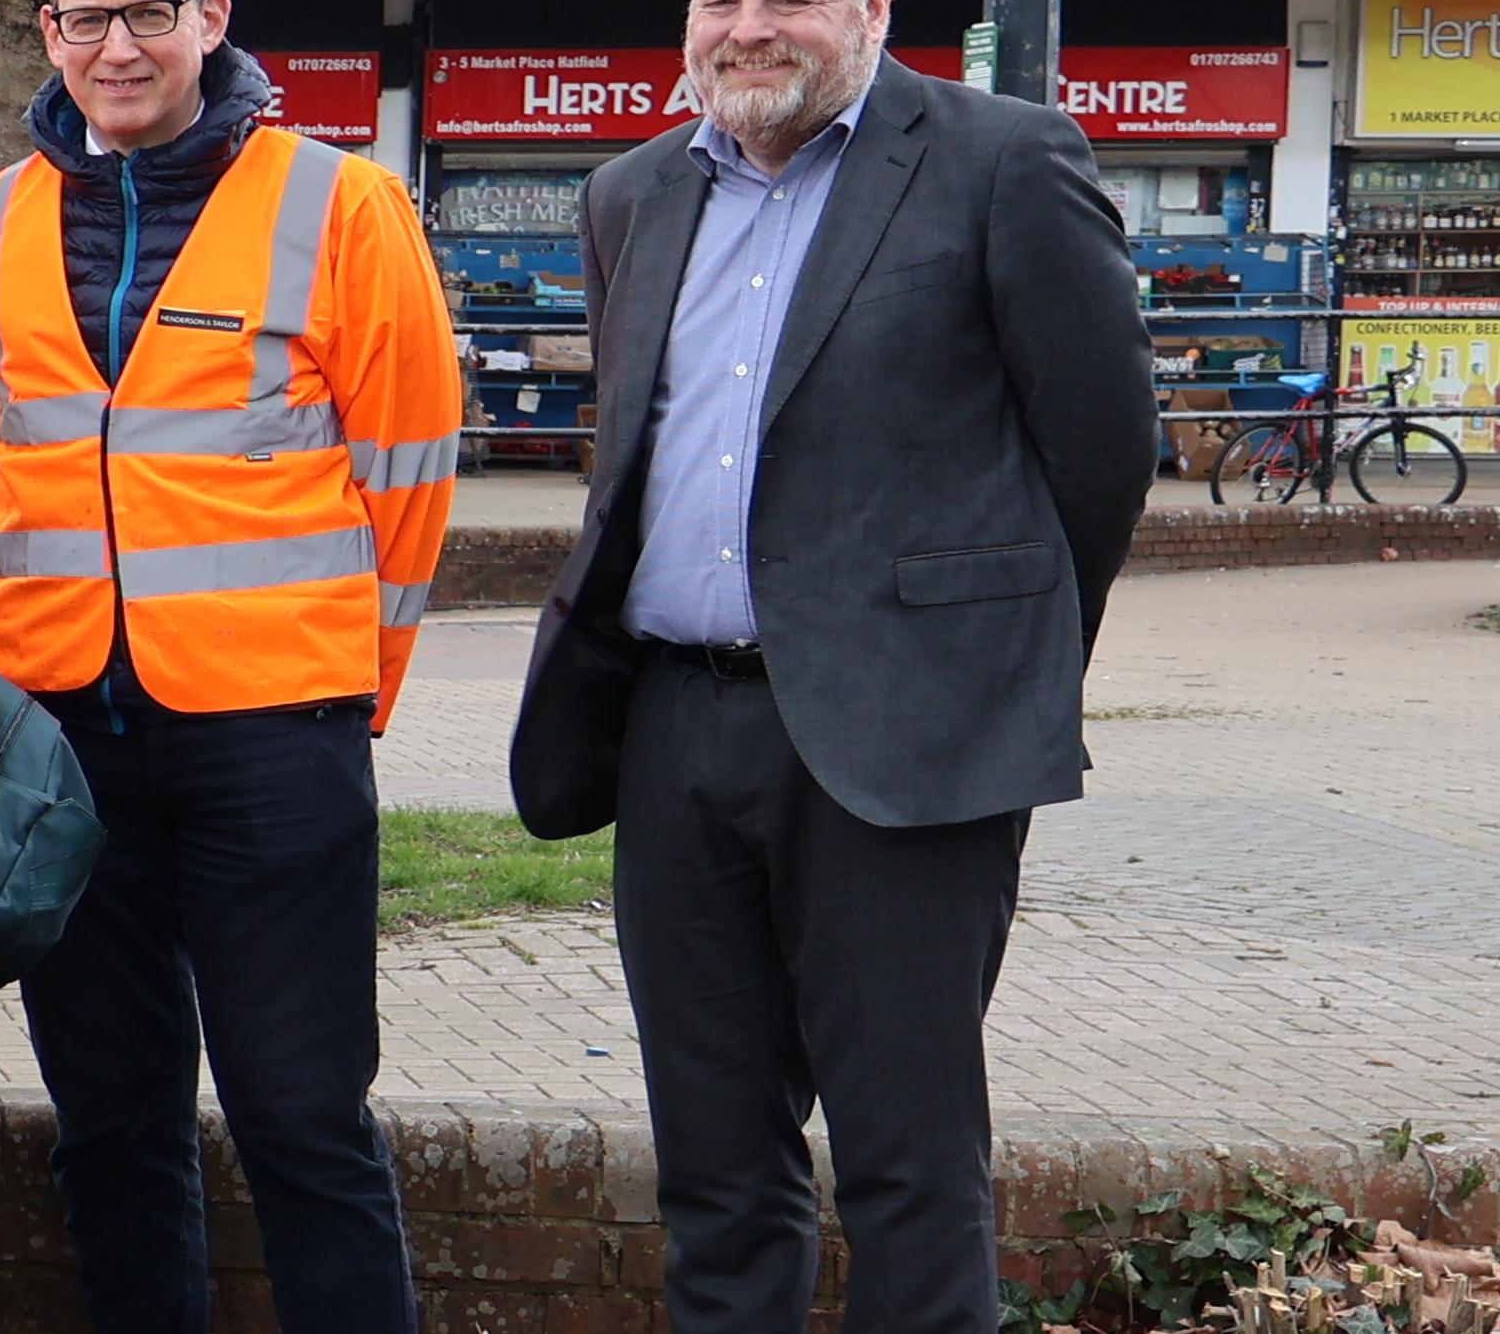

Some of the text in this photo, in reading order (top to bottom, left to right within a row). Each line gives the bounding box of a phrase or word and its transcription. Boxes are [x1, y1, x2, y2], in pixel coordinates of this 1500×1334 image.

[1390, 7, 1500, 59] Hert
[288, 59, 372, 71] 01707266743
[439, 56, 448, 68] 3
[459, 56, 468, 68] 5
[471, 56, 516, 68] Market
[519, 56, 555, 68] Place
[558, 56, 609, 69] Hatfield
[1190, 53, 1279, 66] 01707266743
[523, 74, 652, 116] HERTS
[1390, 111, 1500, 123] 1 MARKET PLAC
[436, 120, 593, 135] info@hertsafroshop.com
[1117, 119, 1278, 135] www.hertsafroshop.com
[531, 202, 581, 223] MEA
[1378, 301, 1407, 311] TOP
[160, 314, 205, 327] HENDERSON
[213, 320, 240, 329] TAYLOR
[1356, 322, 1500, 335] CONFECTIONERY, BEE
